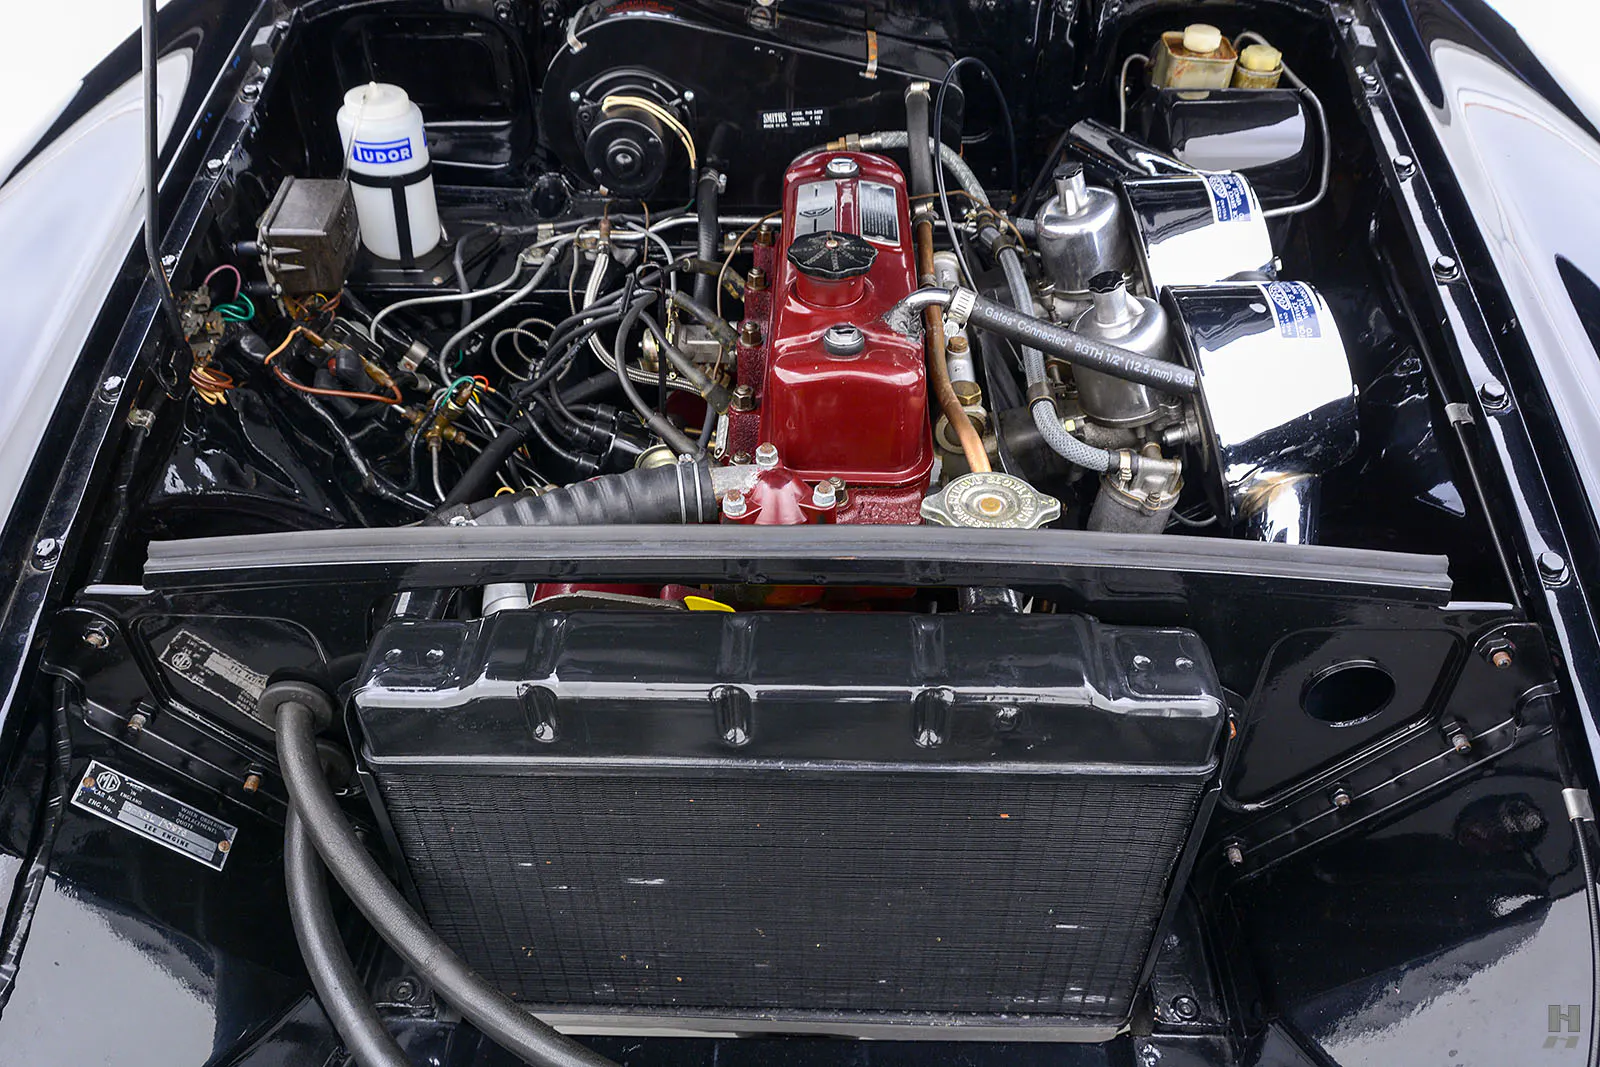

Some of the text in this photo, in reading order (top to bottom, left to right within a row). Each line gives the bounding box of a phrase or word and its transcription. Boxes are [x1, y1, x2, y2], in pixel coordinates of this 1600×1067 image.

[763, 112, 787, 123] SMITHS
[355, 140, 411, 162] TUDOR
[1125, 358, 1149, 374] (12.5
[1150, 367, 1173, 382] mm)
[1175, 372, 1195, 387] SAE
[97, 771, 120, 792] MG
[119, 791, 143, 806] ENGLAND
[180, 806, 198, 819] WHEN
[175, 818, 194, 830] QUOTE
[143, 823, 190, 849] SEE ENGINE
